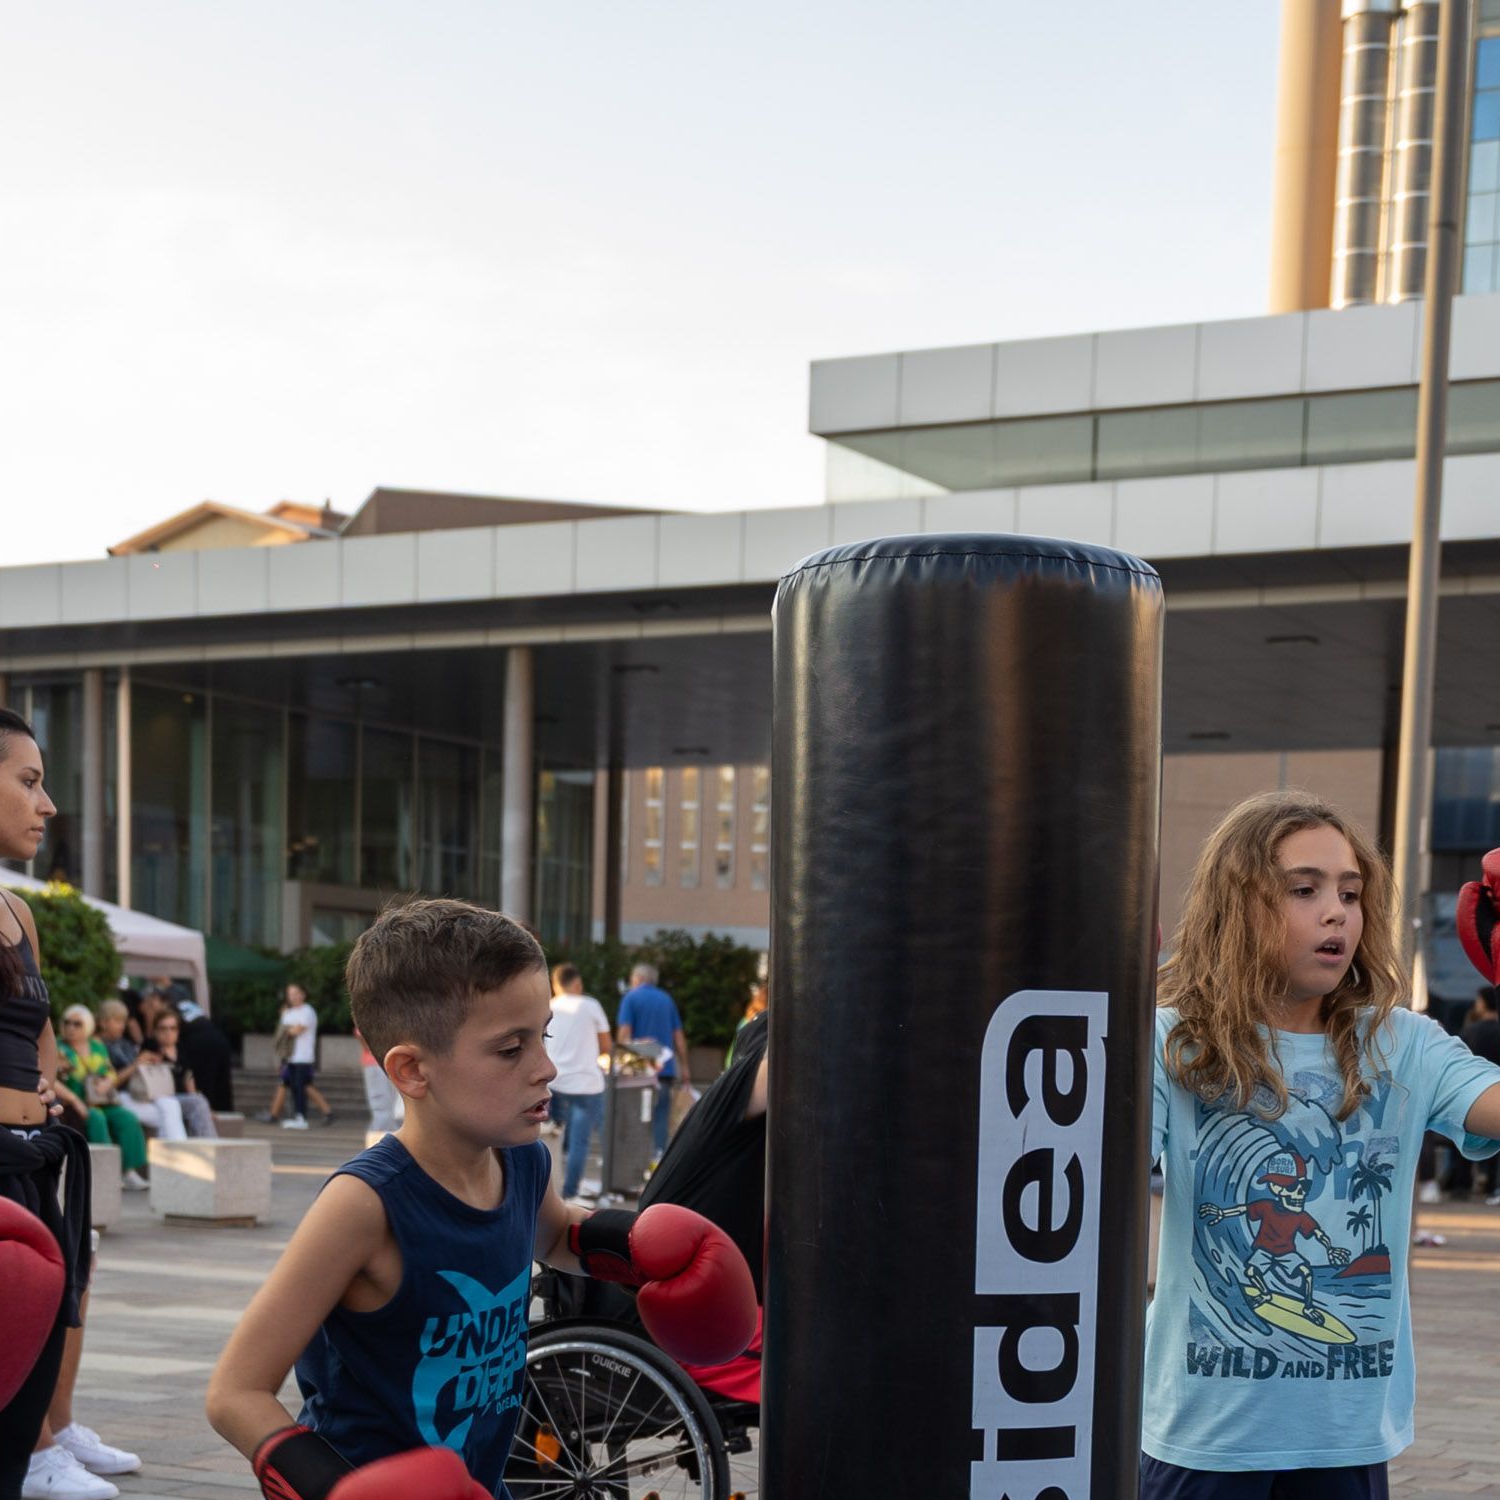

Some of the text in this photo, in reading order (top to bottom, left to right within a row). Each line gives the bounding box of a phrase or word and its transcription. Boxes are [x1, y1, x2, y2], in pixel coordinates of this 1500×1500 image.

[453, 1338, 527, 1411] DEEP
[591, 1353, 632, 1378] QUICKIE
[1186, 1338, 1395, 1381] WILD AND FREE
